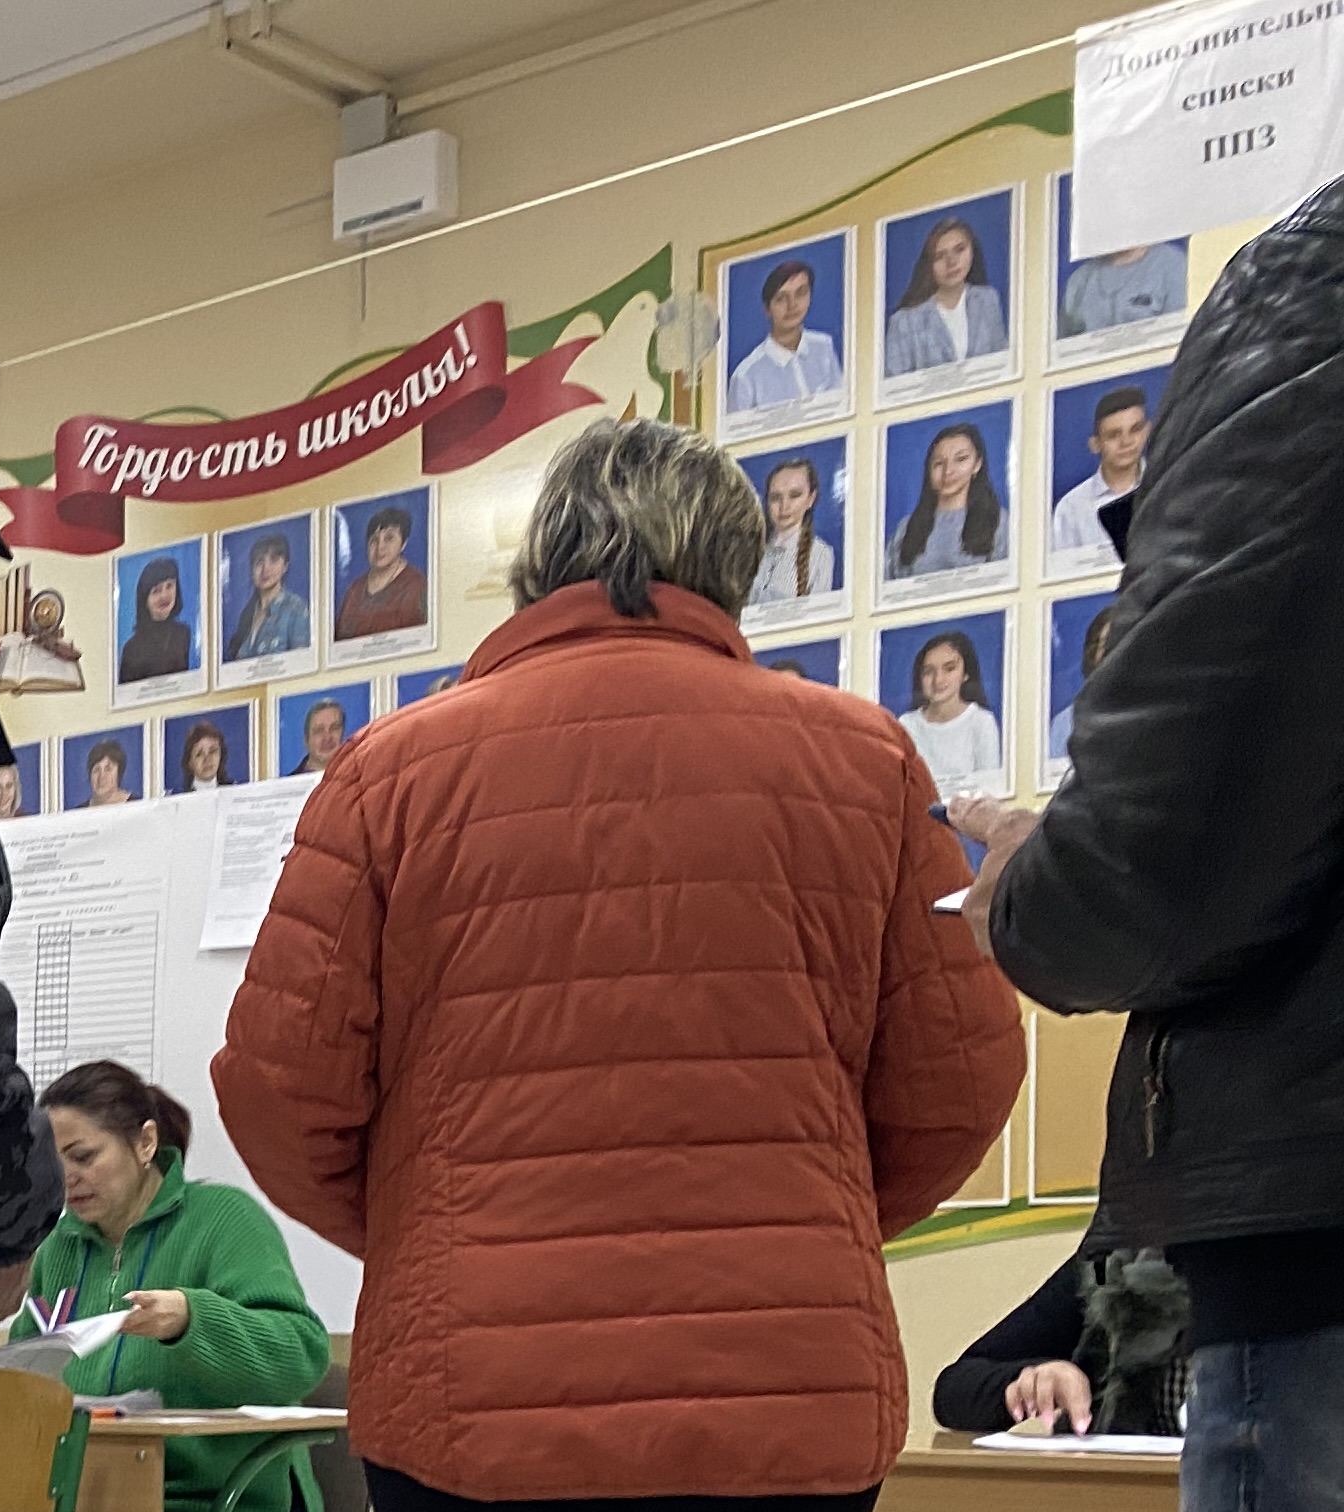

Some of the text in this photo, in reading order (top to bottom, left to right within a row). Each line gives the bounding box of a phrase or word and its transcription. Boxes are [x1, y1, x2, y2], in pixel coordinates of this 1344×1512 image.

[1182, 66, 1296, 112] списки
[77, 321, 479, 498] Гордость школы!
